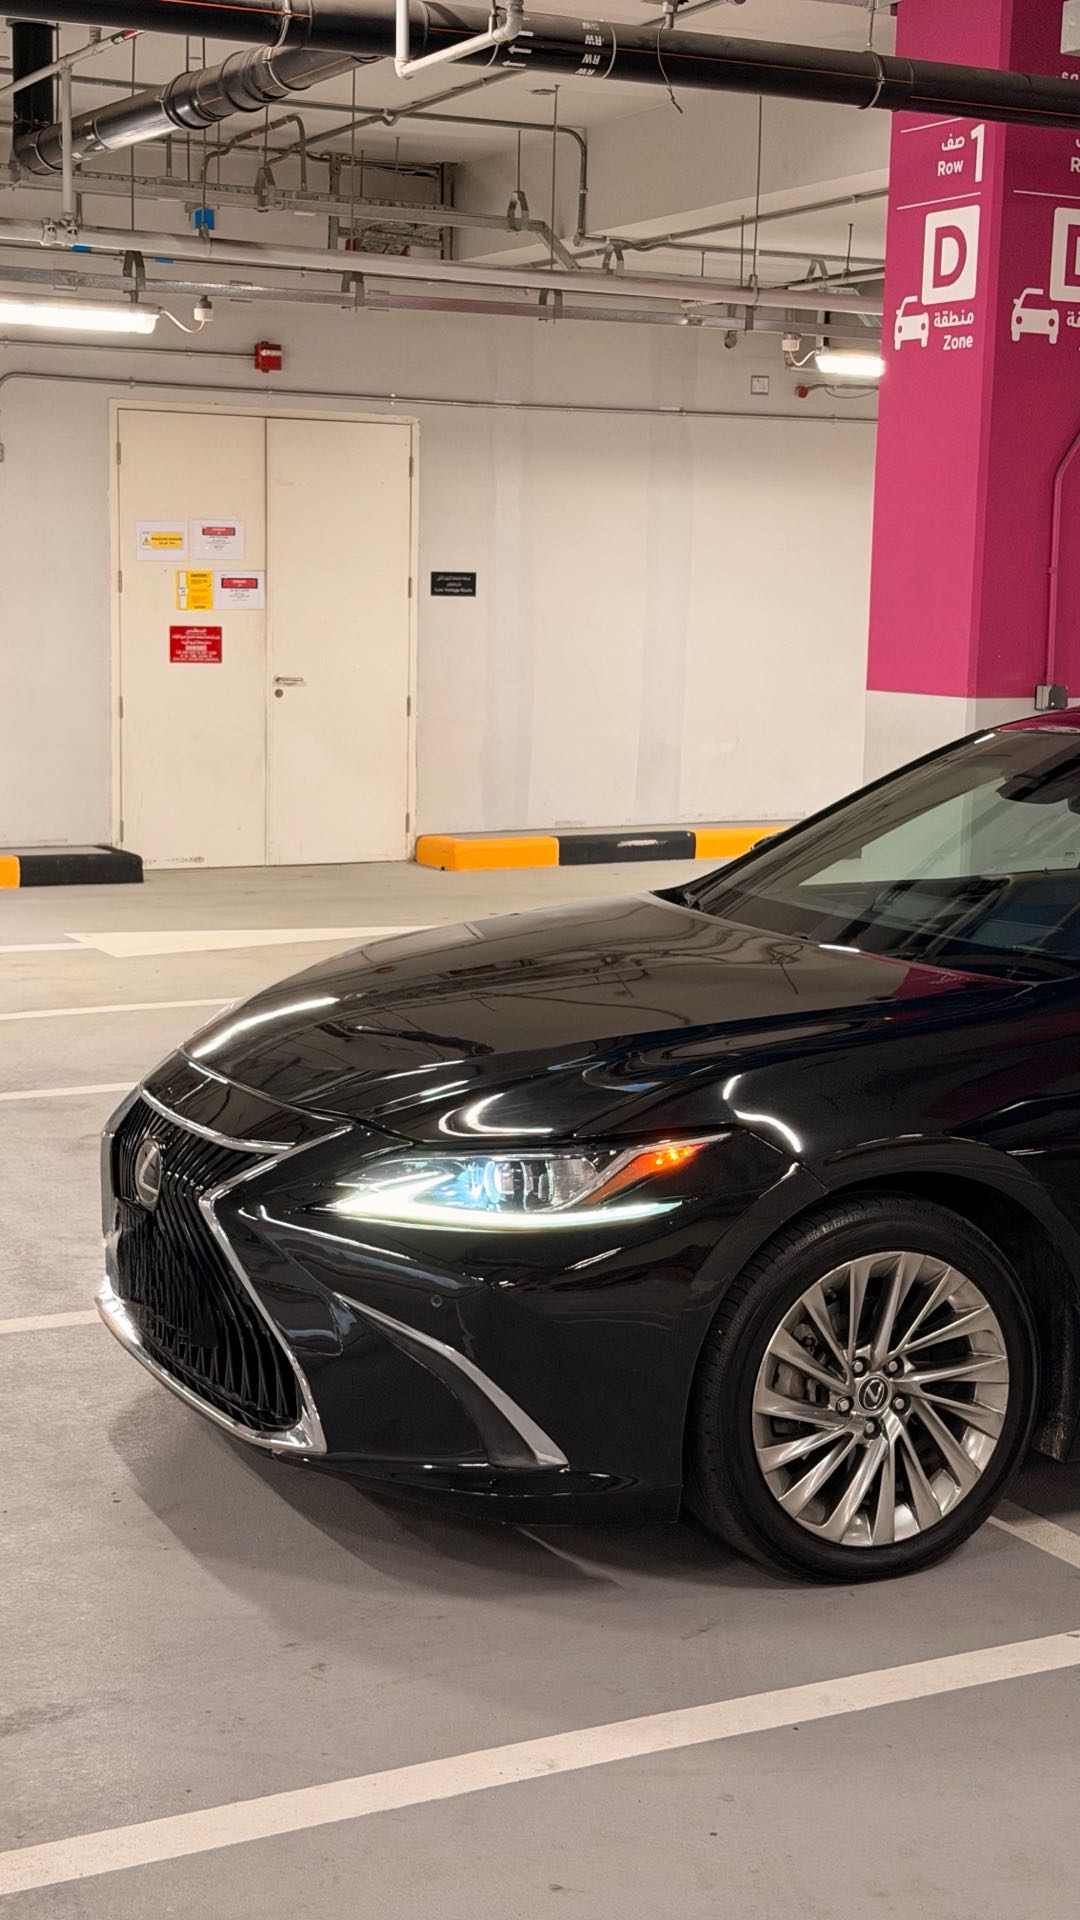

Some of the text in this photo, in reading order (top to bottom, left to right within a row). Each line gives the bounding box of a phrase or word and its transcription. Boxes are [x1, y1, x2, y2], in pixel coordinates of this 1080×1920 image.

[585, 34, 603, 46] RW
[581, 53, 601, 65] RW
[941, 133, 965, 151] صف
[971, 124, 985, 183] 1
[937, 160, 964, 176] Row
[932, 224, 967, 288] D
[933, 309, 974, 328] منطقة
[943, 335, 974, 350] Zone
